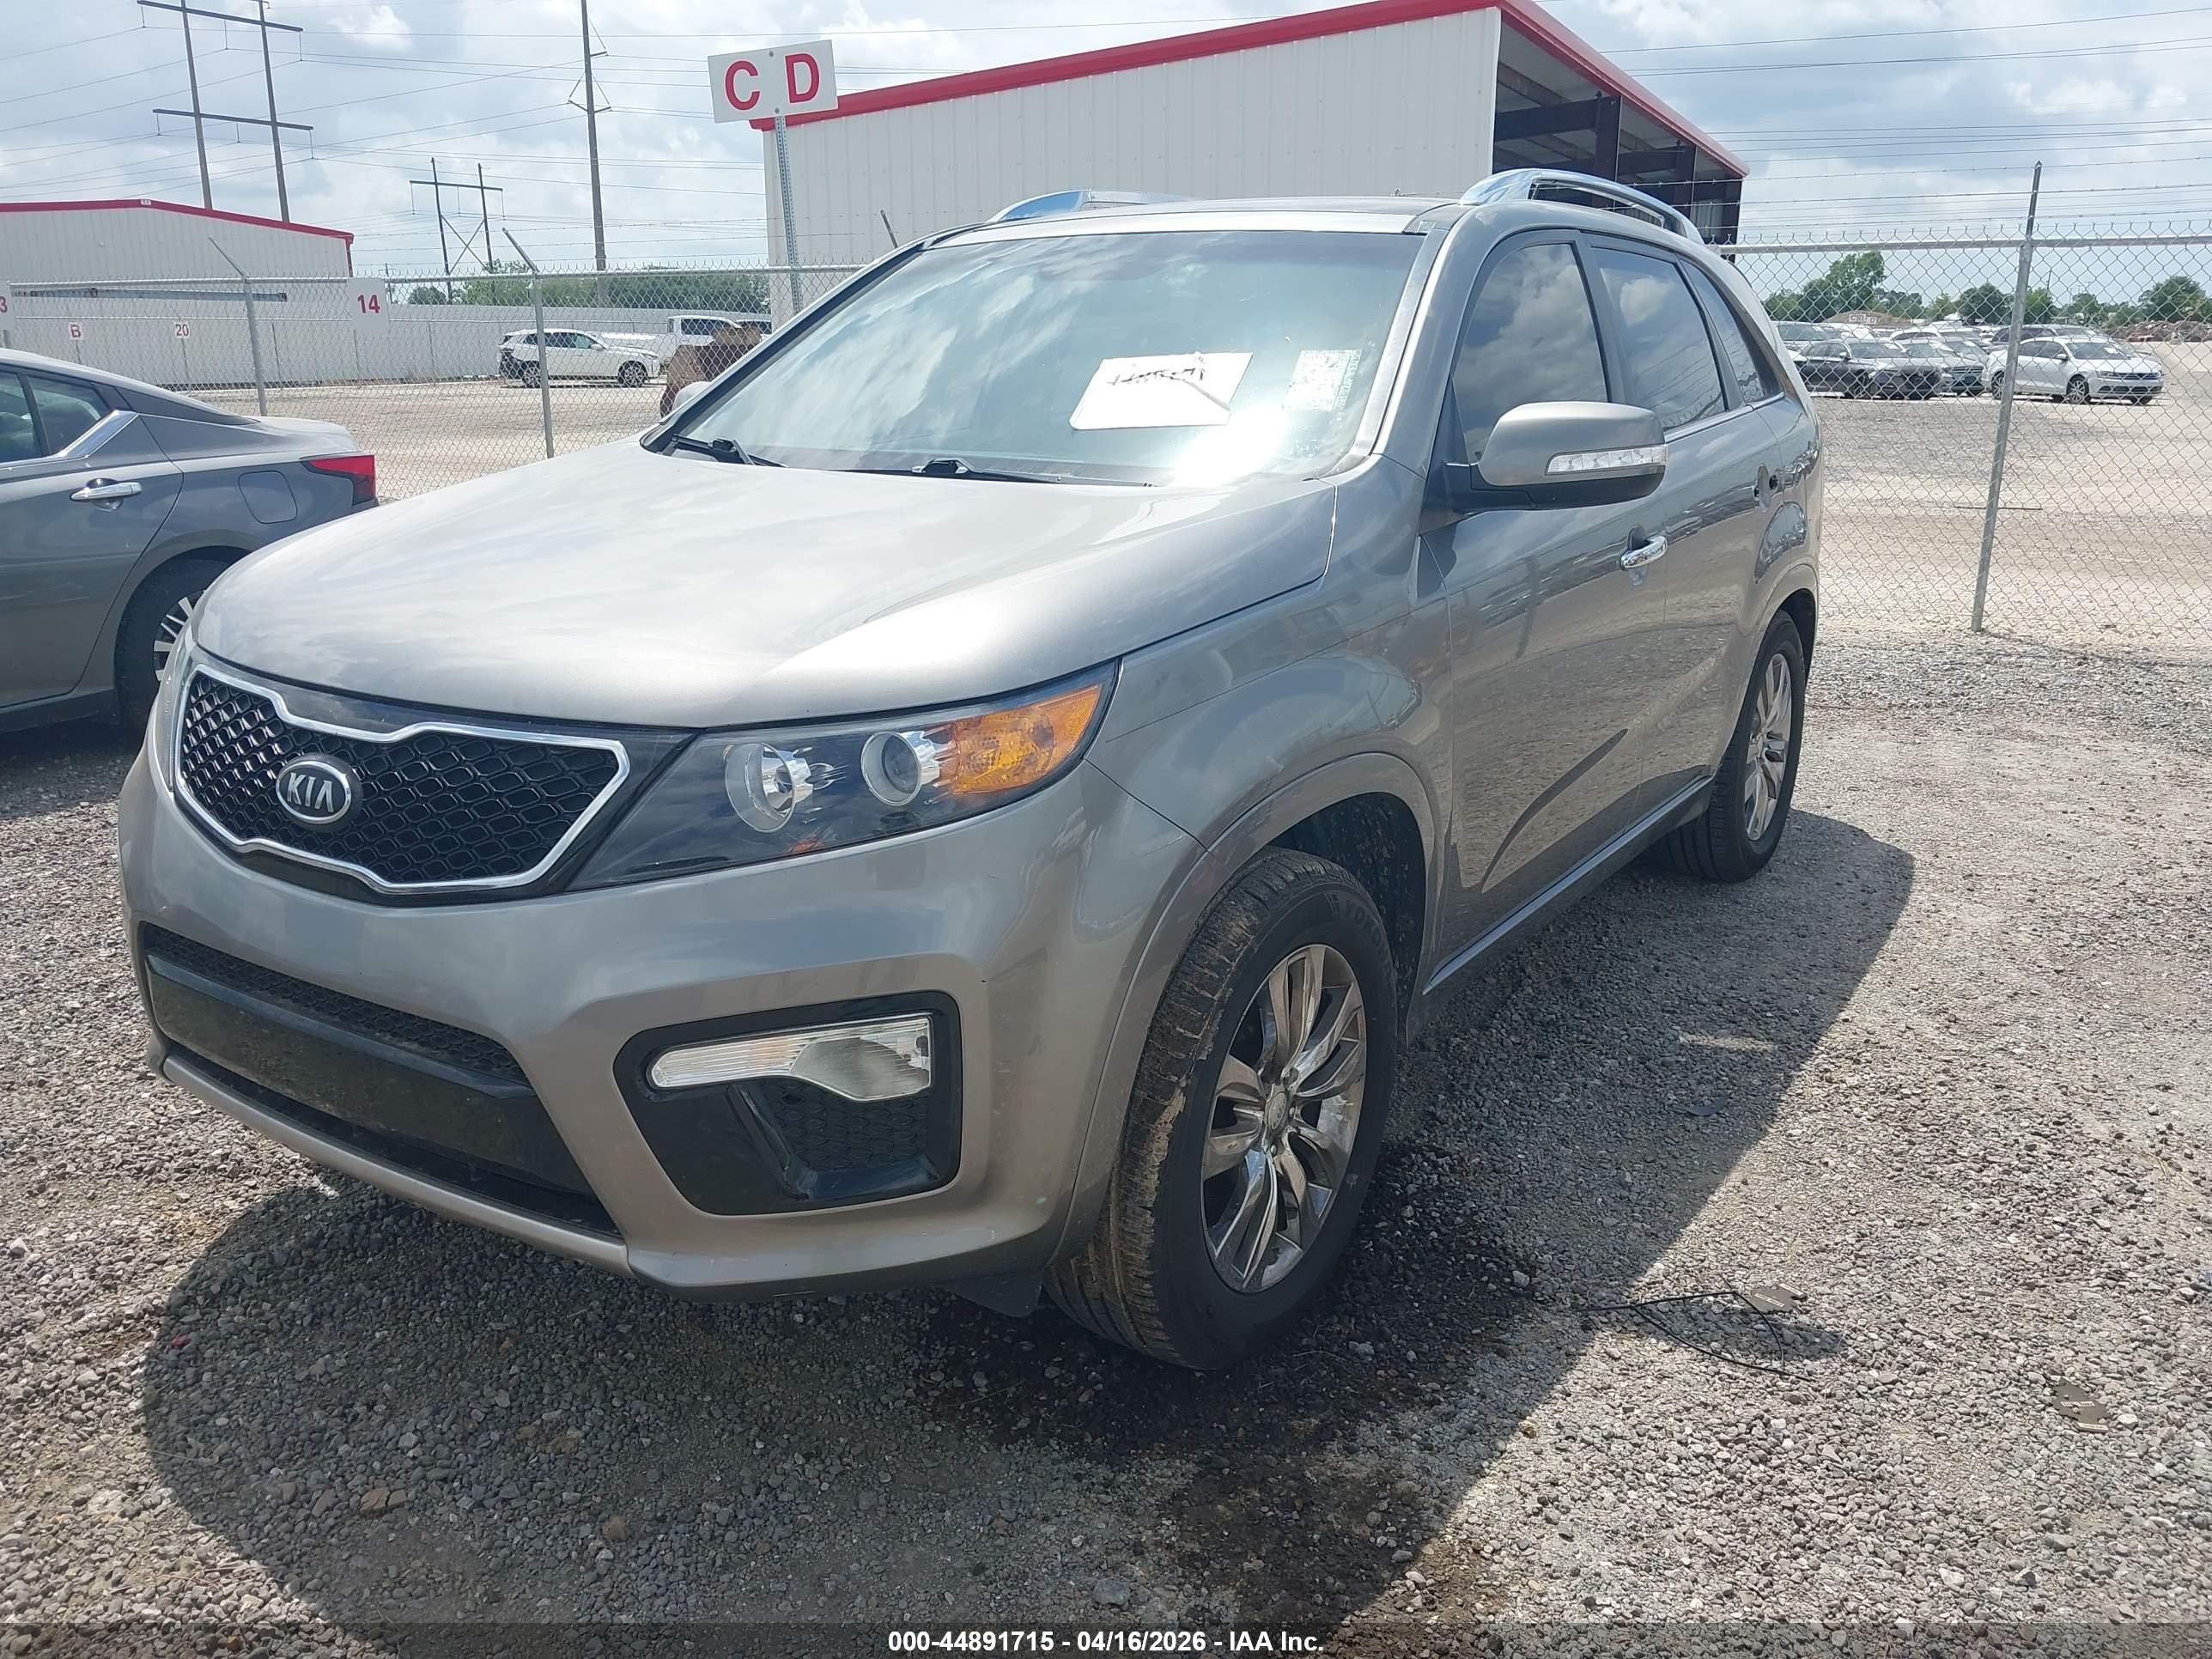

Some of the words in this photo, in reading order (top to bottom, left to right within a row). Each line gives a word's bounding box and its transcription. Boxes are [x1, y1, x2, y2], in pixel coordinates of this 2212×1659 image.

[725, 60, 761, 111] C
[785, 53, 820, 104] D
[357, 295, 380, 313] 14
[70, 325, 82, 338] B
[175, 324, 189, 337] 20
[286, 772, 334, 813] KIA
